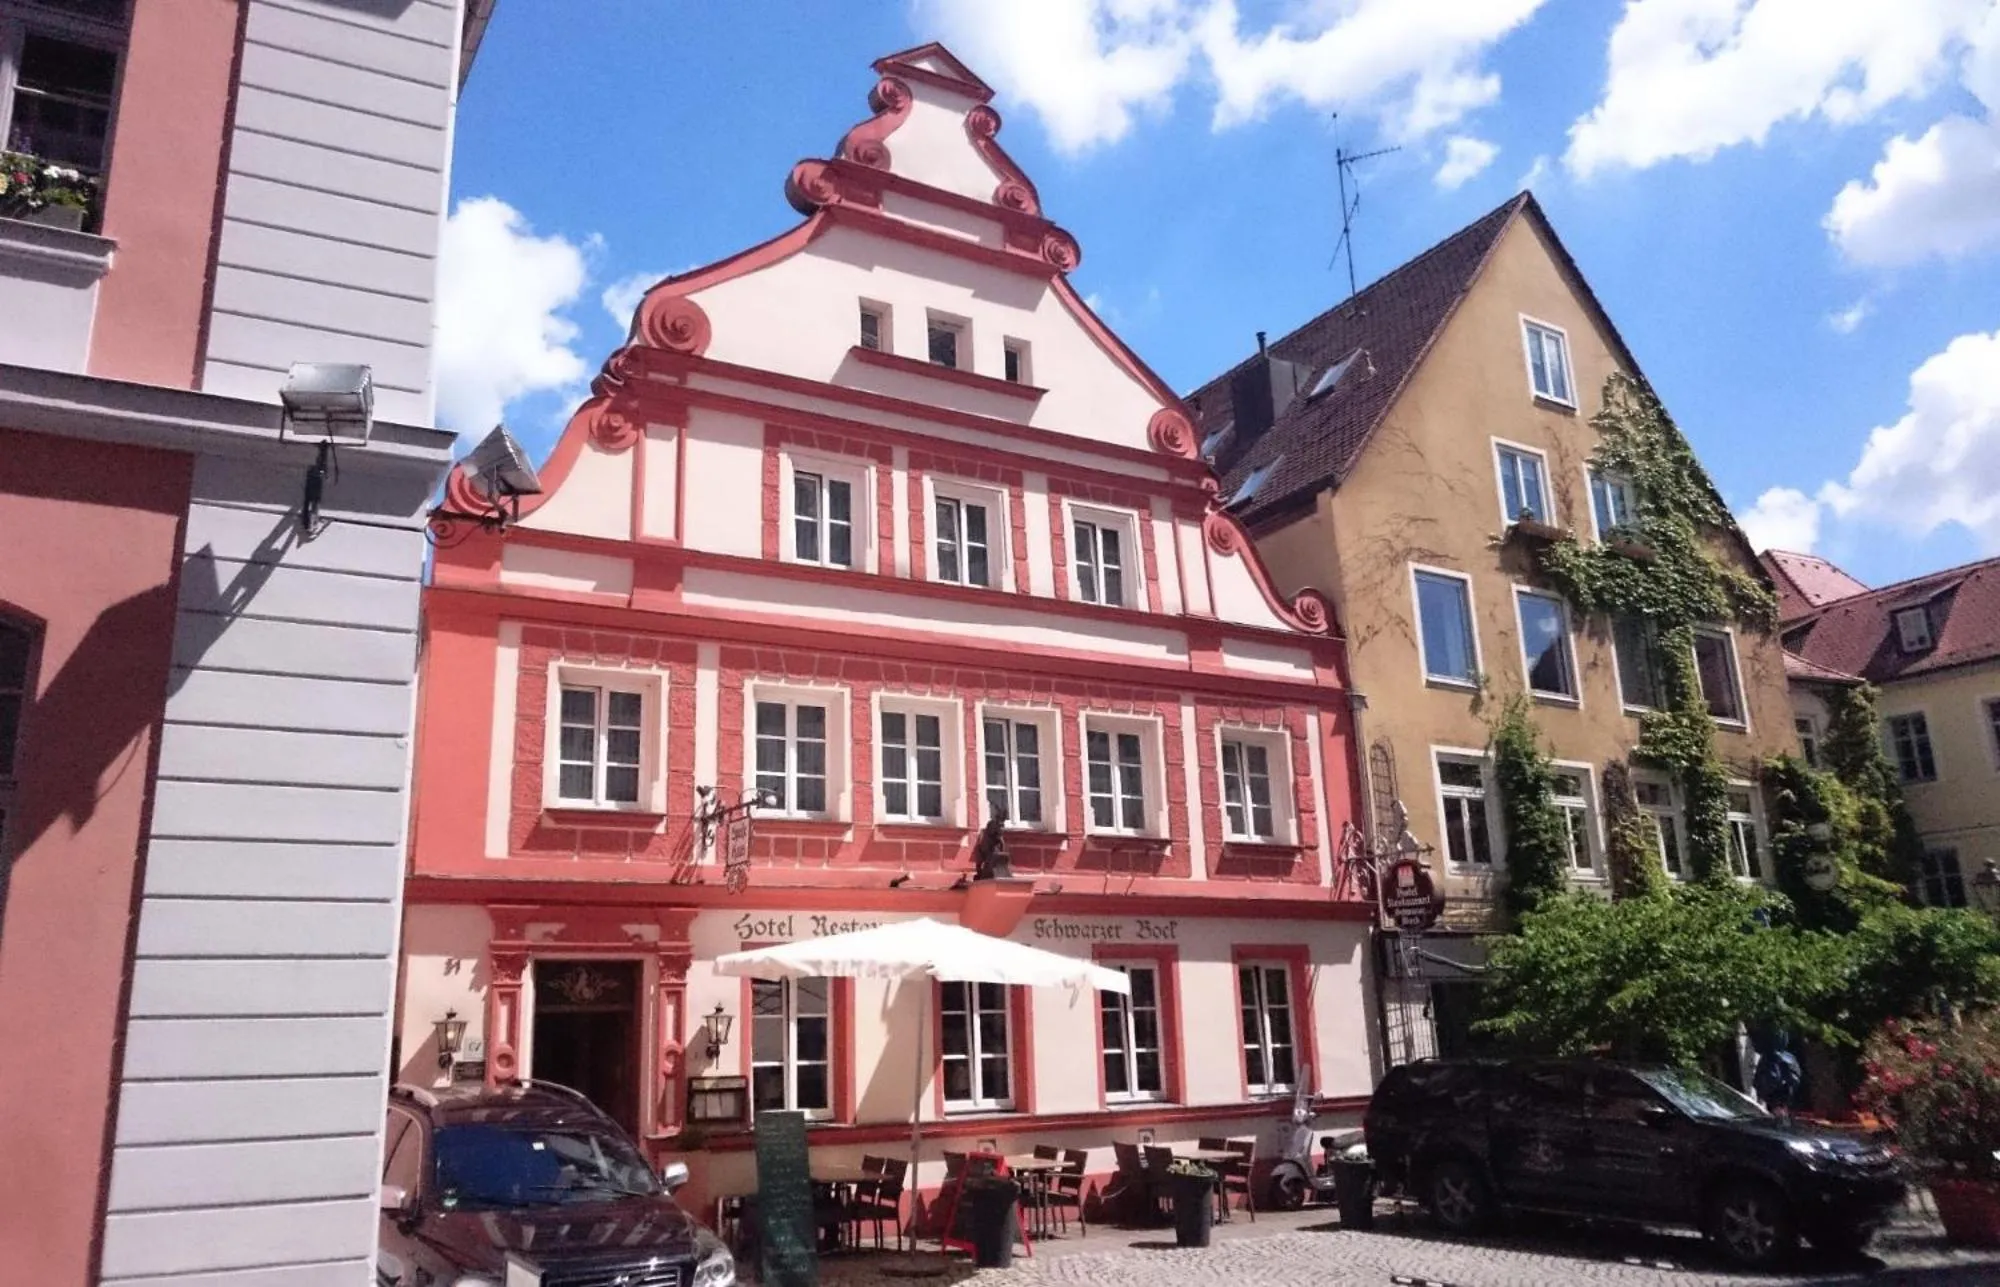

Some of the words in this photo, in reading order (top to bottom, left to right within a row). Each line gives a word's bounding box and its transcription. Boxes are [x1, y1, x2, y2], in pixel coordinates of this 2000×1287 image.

[734, 913, 793, 939] Hotel
[1034, 917, 1123, 939] Schwarzer
[1135, 919, 1178, 939] Bock
